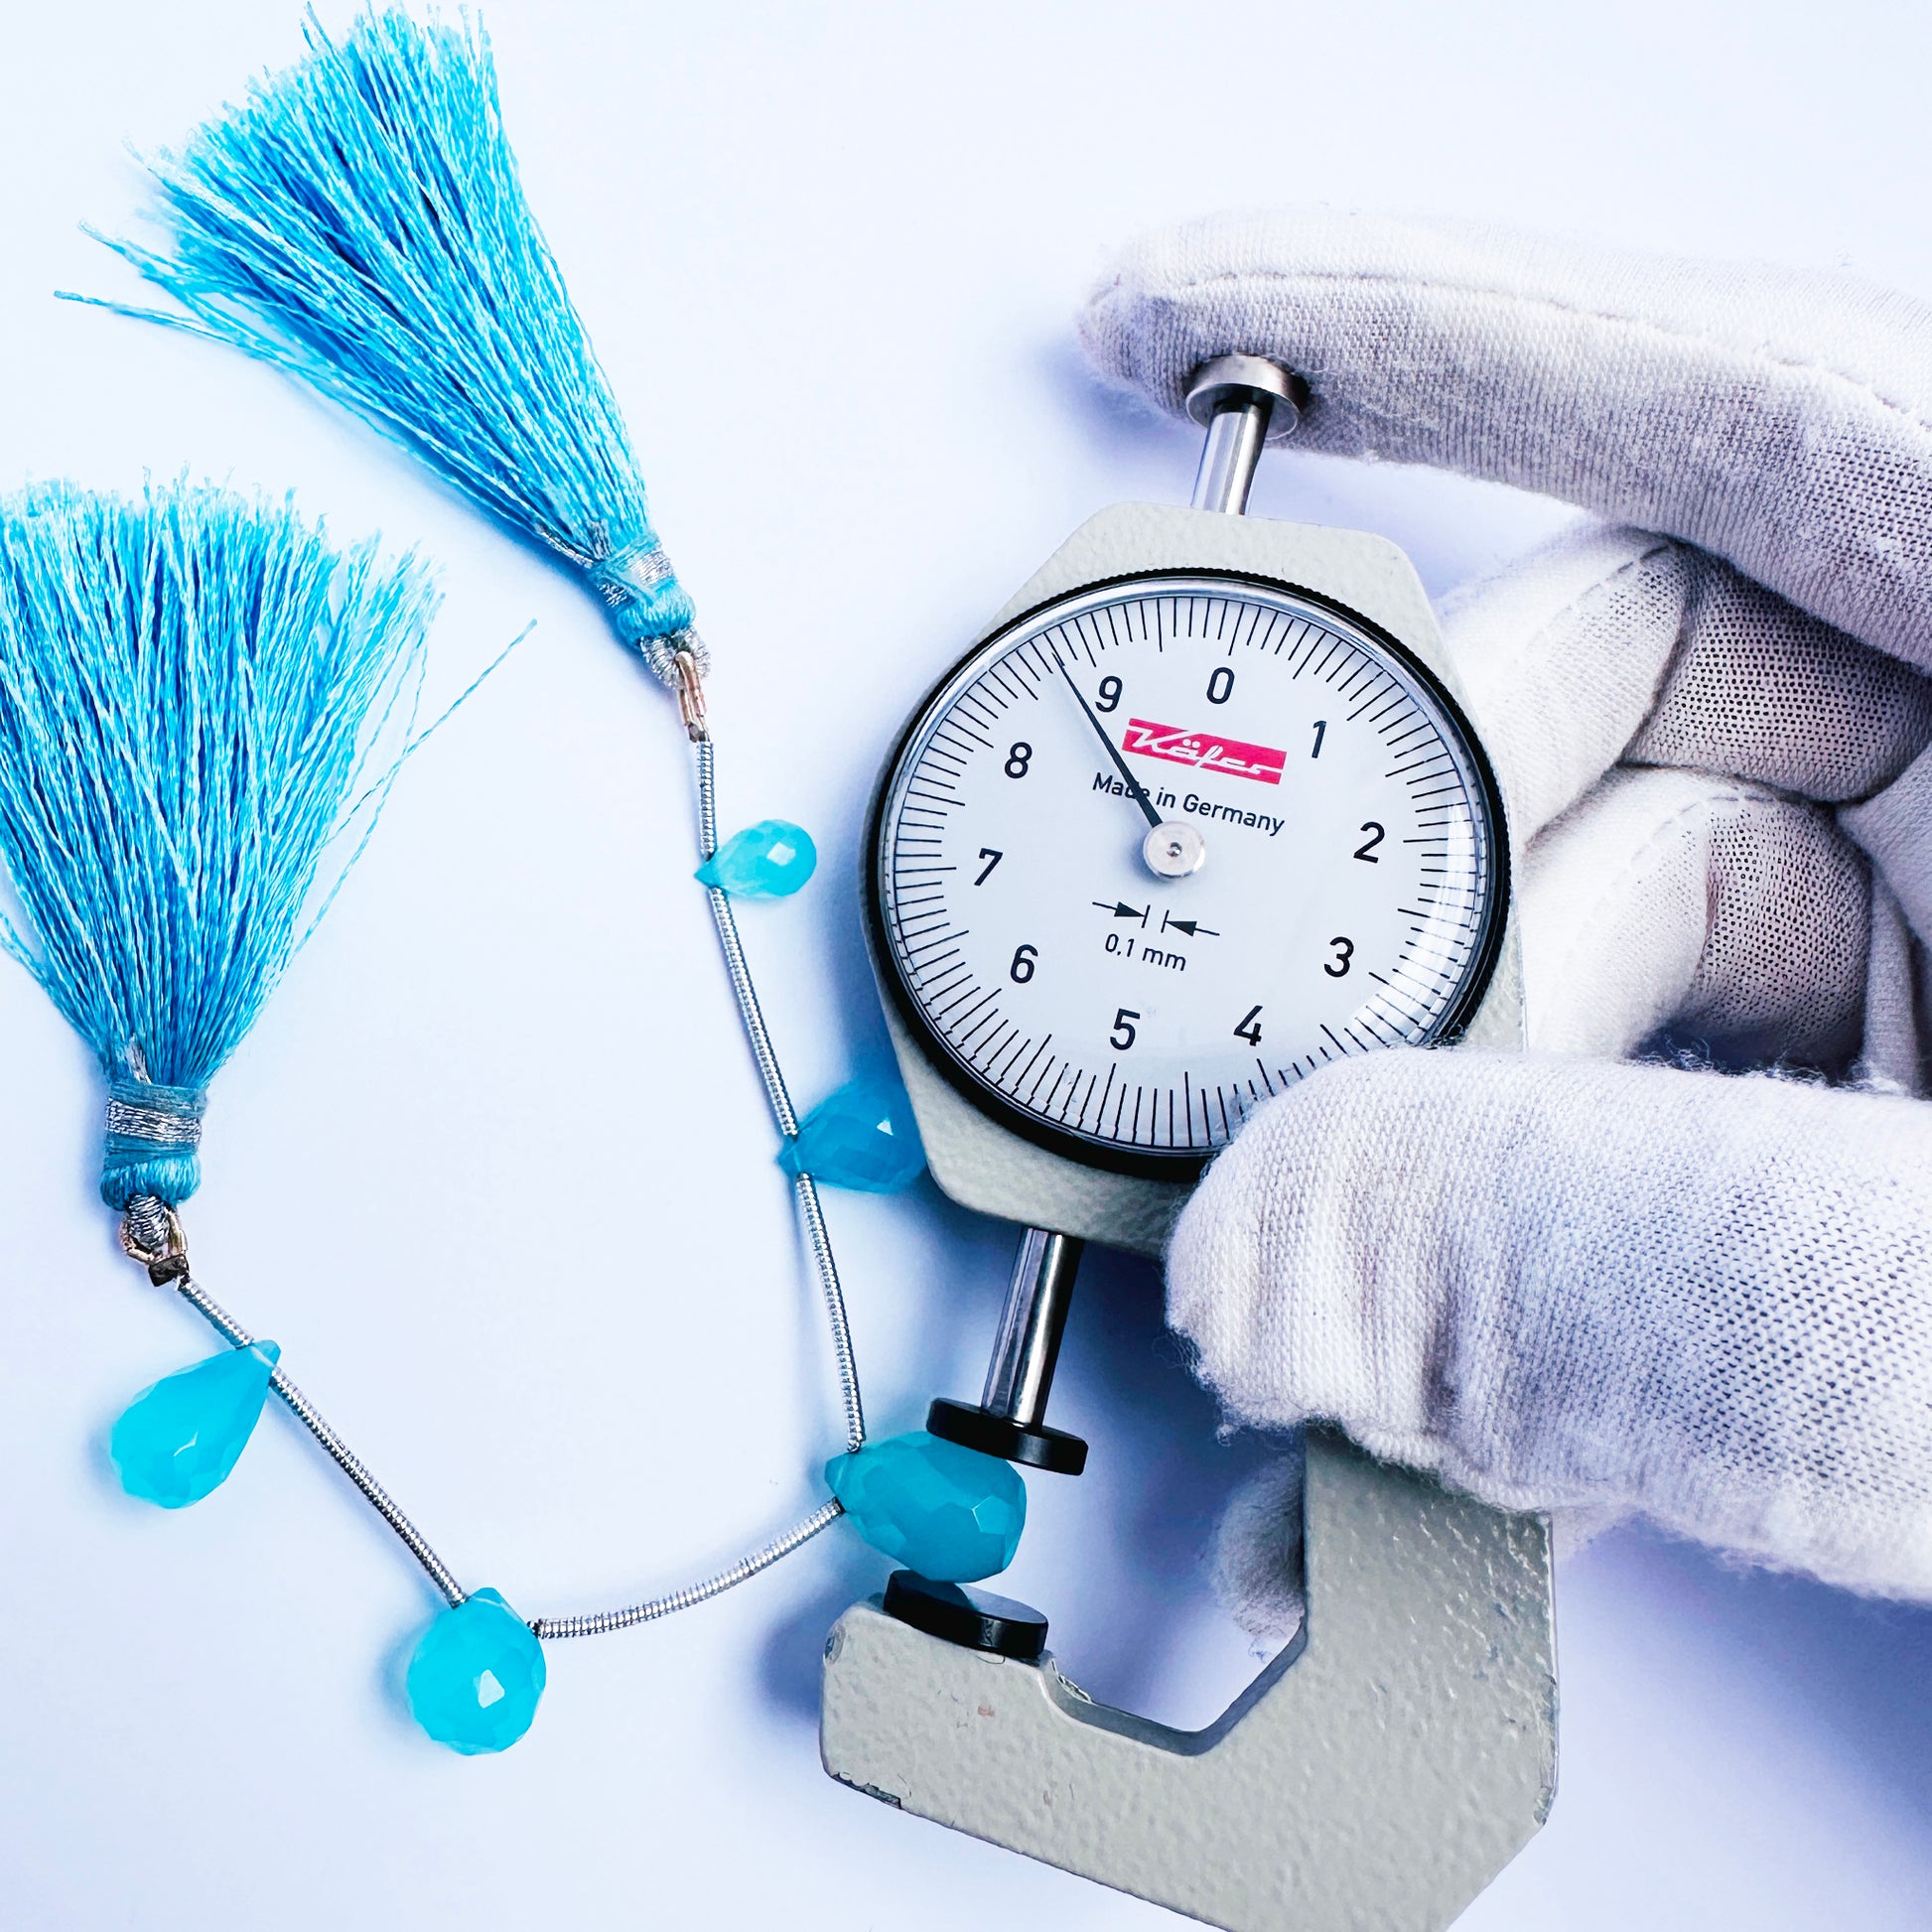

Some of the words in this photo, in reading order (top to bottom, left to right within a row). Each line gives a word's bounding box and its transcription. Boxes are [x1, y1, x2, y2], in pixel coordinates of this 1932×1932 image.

[1094, 675, 1123, 713] 9
[1205, 666, 1235, 705] 0
[1310, 720, 1327, 759] 1
[1003, 742, 1033, 779] 8
[1156, 786, 1176, 809] in
[1182, 793, 1286, 837] Germany
[1353, 821, 1386, 864] 2
[973, 847, 1004, 887] 7
[1009, 943, 1038, 984] 6
[1142, 947, 1186, 972] mm
[1323, 936, 1354, 978] 3
[1109, 1008, 1141, 1051] 5
[1233, 1005, 1264, 1047] 4
